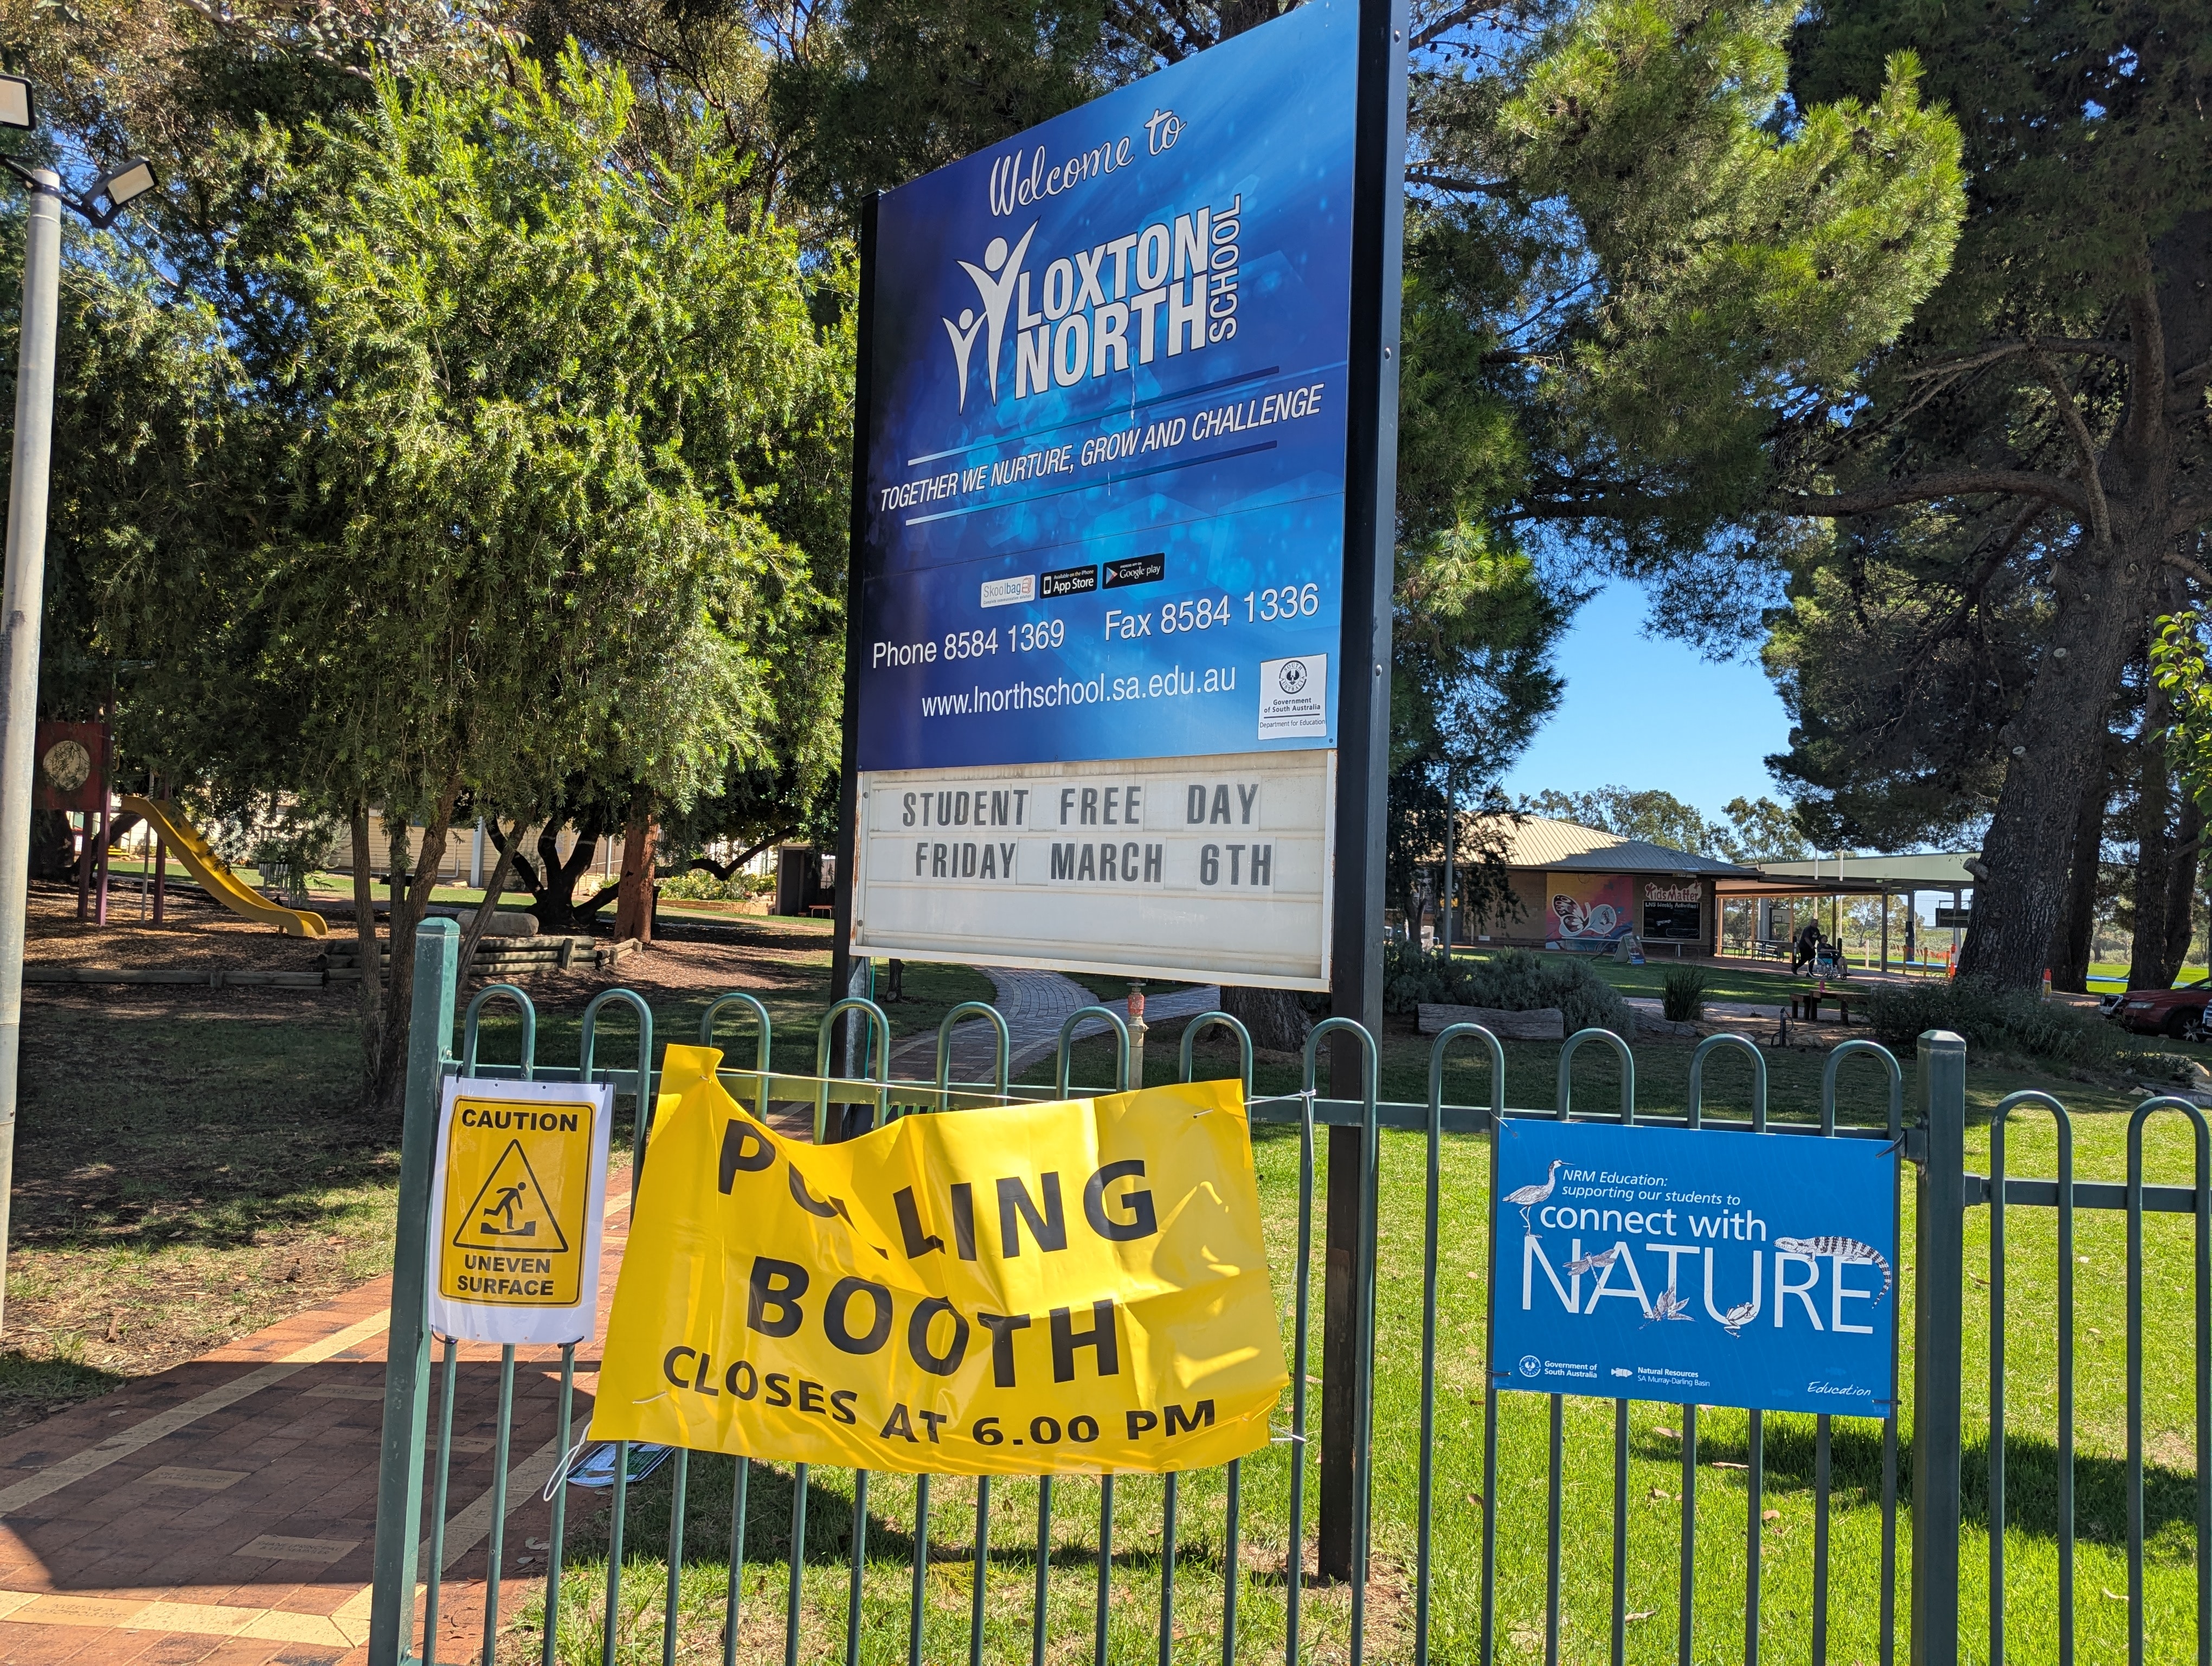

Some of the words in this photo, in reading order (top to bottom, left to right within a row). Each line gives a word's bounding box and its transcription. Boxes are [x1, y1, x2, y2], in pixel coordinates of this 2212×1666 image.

[990, 137, 1134, 216] Welcome
[1144, 109, 1187, 156] to
[1017, 206, 1210, 331] LOXTON
[1209, 194, 1242, 343] SCHOOL
[1014, 275, 1207, 400] NORTH
[881, 471, 959, 511] TOGETHER
[962, 465, 988, 494] WE
[991, 444, 1073, 487] NURTURE,
[1081, 428, 1141, 467] GROW
[1141, 418, 1186, 453] AND
[1192, 383, 1325, 441] CHALLENGE
[1120, 568, 1144, 579] Google
[1147, 565, 1161, 576] play
[983, 582, 1021, 598] Skoolbag
[1053, 580, 1072, 592] App
[1074, 577, 1094, 589] Store
[1105, 609, 1151, 642] Fax
[1161, 595, 1231, 635] 8584
[1244, 583, 1319, 623] 1336
[872, 642, 937, 669] Phone
[944, 628, 998, 661] 8584
[1007, 620, 1065, 651] 1369
[1284, 662, 1303, 672] SOUTH
[922, 667, 1236, 717] www.lnorthschool.sa.edu.au
[1281, 676, 1305, 691] AUSTRALIA
[1273, 697, 1311, 706] Government
[1259, 721, 1289, 729] Department
[902, 789, 1029, 828] STUDENT
[1059, 785, 1141, 825] FREE
[1187, 783, 1259, 825] DAY
[916, 842, 1016, 880] FRIDAY
[1051, 841, 1162, 883] MARCH
[1200, 844, 1272, 886] 6TH
[462, 1108, 578, 1132] CAUTION
[1562, 1169, 1595, 1182] NRM
[1599, 1172, 1668, 1187] Education:
[718, 1119, 1158, 1262] PLING
[1562, 1186, 1634, 1201] supporting
[1638, 1190, 1662, 1201] our
[1665, 1191, 1722, 1204] students
[1726, 1194, 1741, 1205] to
[1540, 1205, 1677, 1237] connect
[1689, 1209, 1767, 1241] with
[464, 1254, 550, 1273] UNEVEN
[457, 1275, 554, 1296] SURFACE
[1522, 1237, 1874, 1335] NATURE
[747, 1255, 1120, 1388] BOOTH
[1545, 1360, 1587, 1370] Government
[1545, 1368, 1565, 1376] South
[1566, 1370, 1597, 1378] Australia
[1637, 1367, 1663, 1375] Natural
[1664, 1368, 1699, 1377] Resources
[1648, 1376, 1693, 1386] Murray-Darling
[1807, 1381, 1871, 1396] Education
[663, 1345, 858, 1425] CLOSES
[879, 1402, 947, 1444] AT
[973, 1415, 1099, 1446] 6.00
[1127, 1398, 1214, 1441] PM
